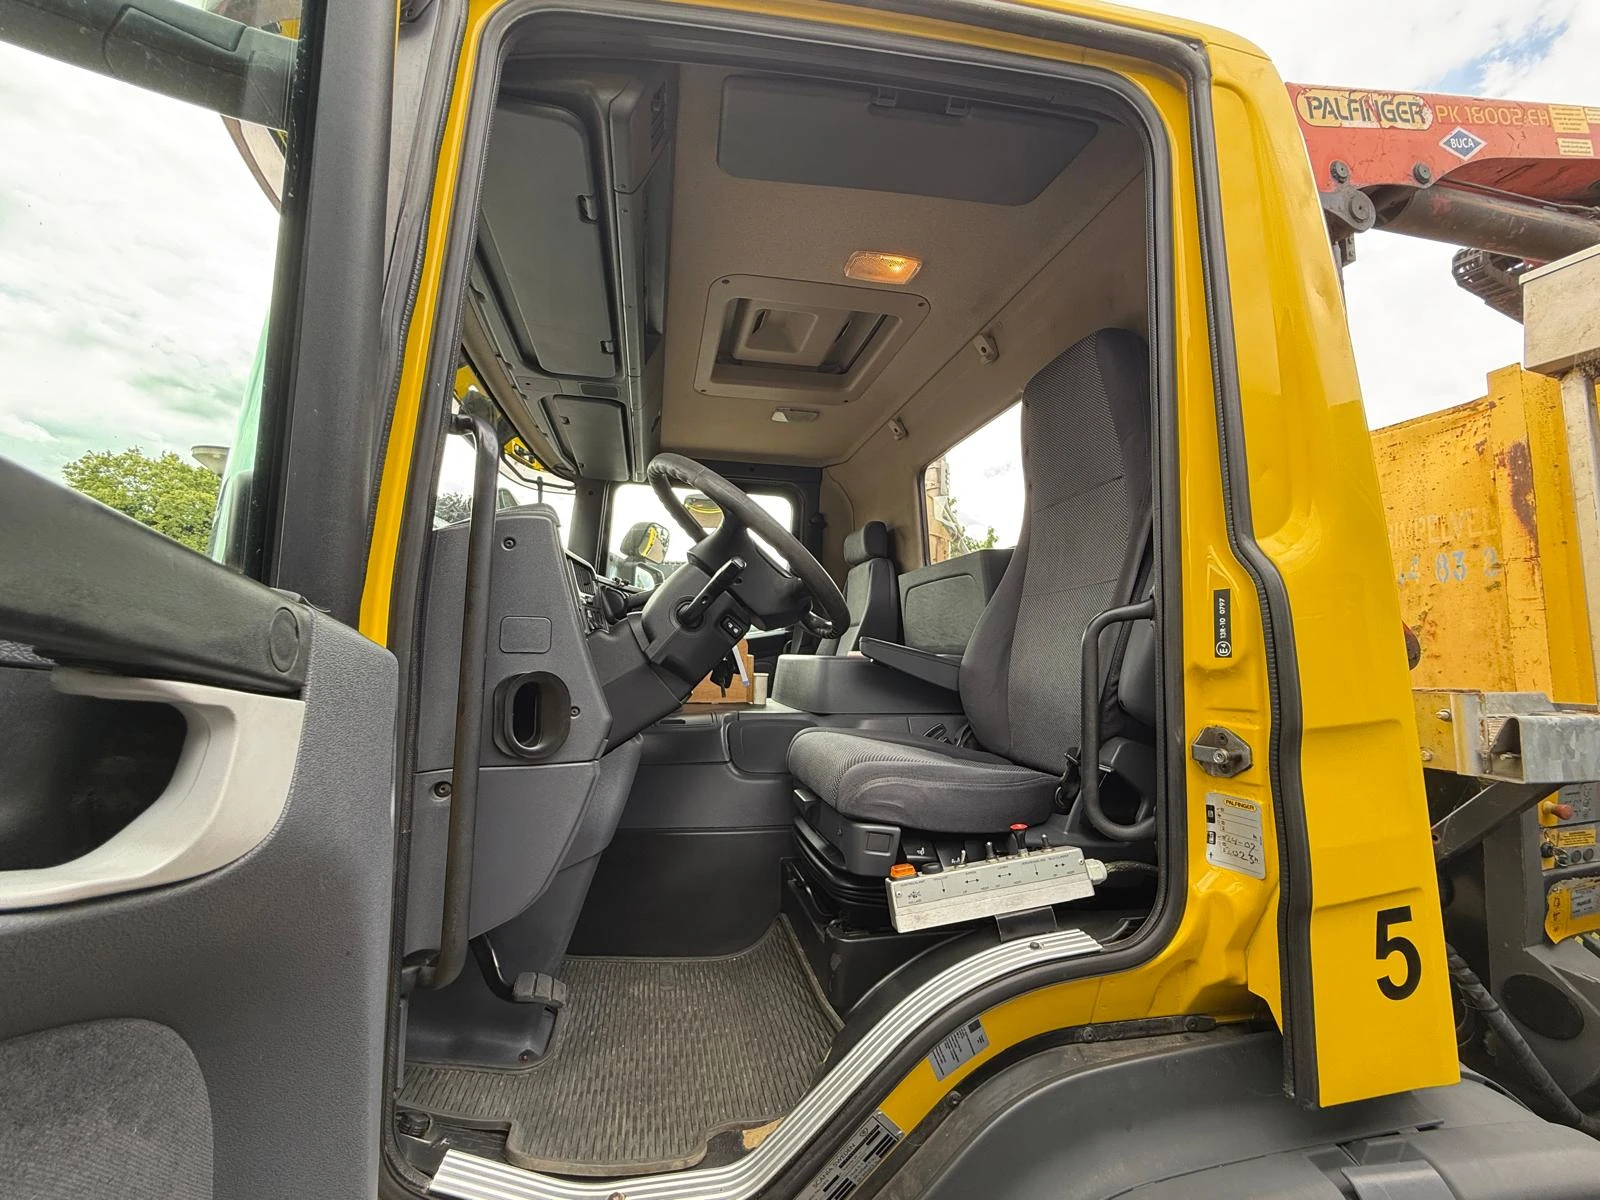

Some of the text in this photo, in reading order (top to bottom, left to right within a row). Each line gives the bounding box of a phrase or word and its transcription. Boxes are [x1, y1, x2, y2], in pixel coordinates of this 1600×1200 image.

[1304, 96, 1426, 124] PALFINGER
[1435, 105, 1461, 123] PK
[1450, 137, 1475, 149] BUCA
[1225, 799, 1255, 811] PALFINGER
[1376, 905, 1421, 1000] 5
